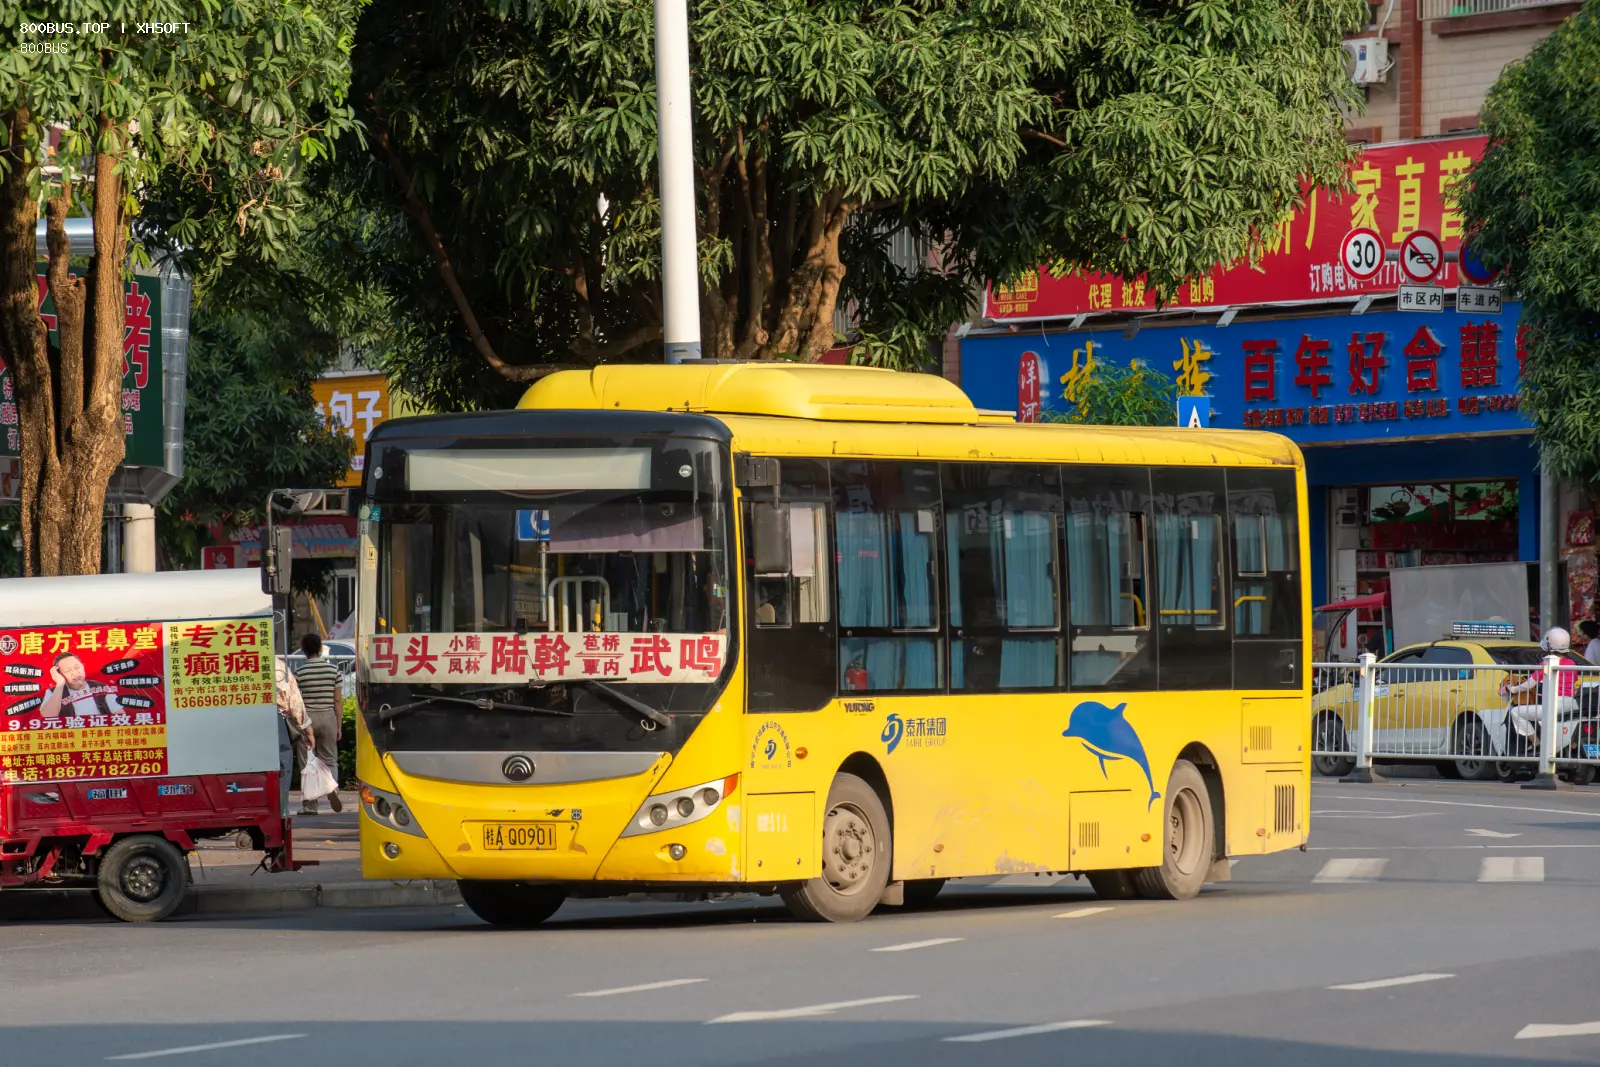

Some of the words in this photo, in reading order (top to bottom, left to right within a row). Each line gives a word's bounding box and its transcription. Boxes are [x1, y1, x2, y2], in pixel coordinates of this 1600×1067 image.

[1266, 150, 1472, 256] 厂家直营
[1352, 240, 1376, 269] 30
[1088, 283, 1112, 309] 代理
[1122, 280, 1145, 307] 批发
[1190, 276, 1214, 304] 团购
[1402, 291, 1441, 306] 市区内
[1461, 292, 1500, 307] 车道内
[1242, 320, 1530, 401] 百年好合囍
[19, 627, 158, 655] 唐方耳鼻堂
[182, 622, 258, 648] 专治
[183, 649, 260, 676] 癫痫
[370, 635, 439, 677] 马头
[449, 635, 481, 651] 小陆
[629, 634, 722, 678] 武鸣
[191, 675, 255, 685] 有效率达98%
[174, 693, 258, 709] 13669687567
[844, 702, 875, 713] YUTONG
[906, 717, 946, 737] 泰禾集团
